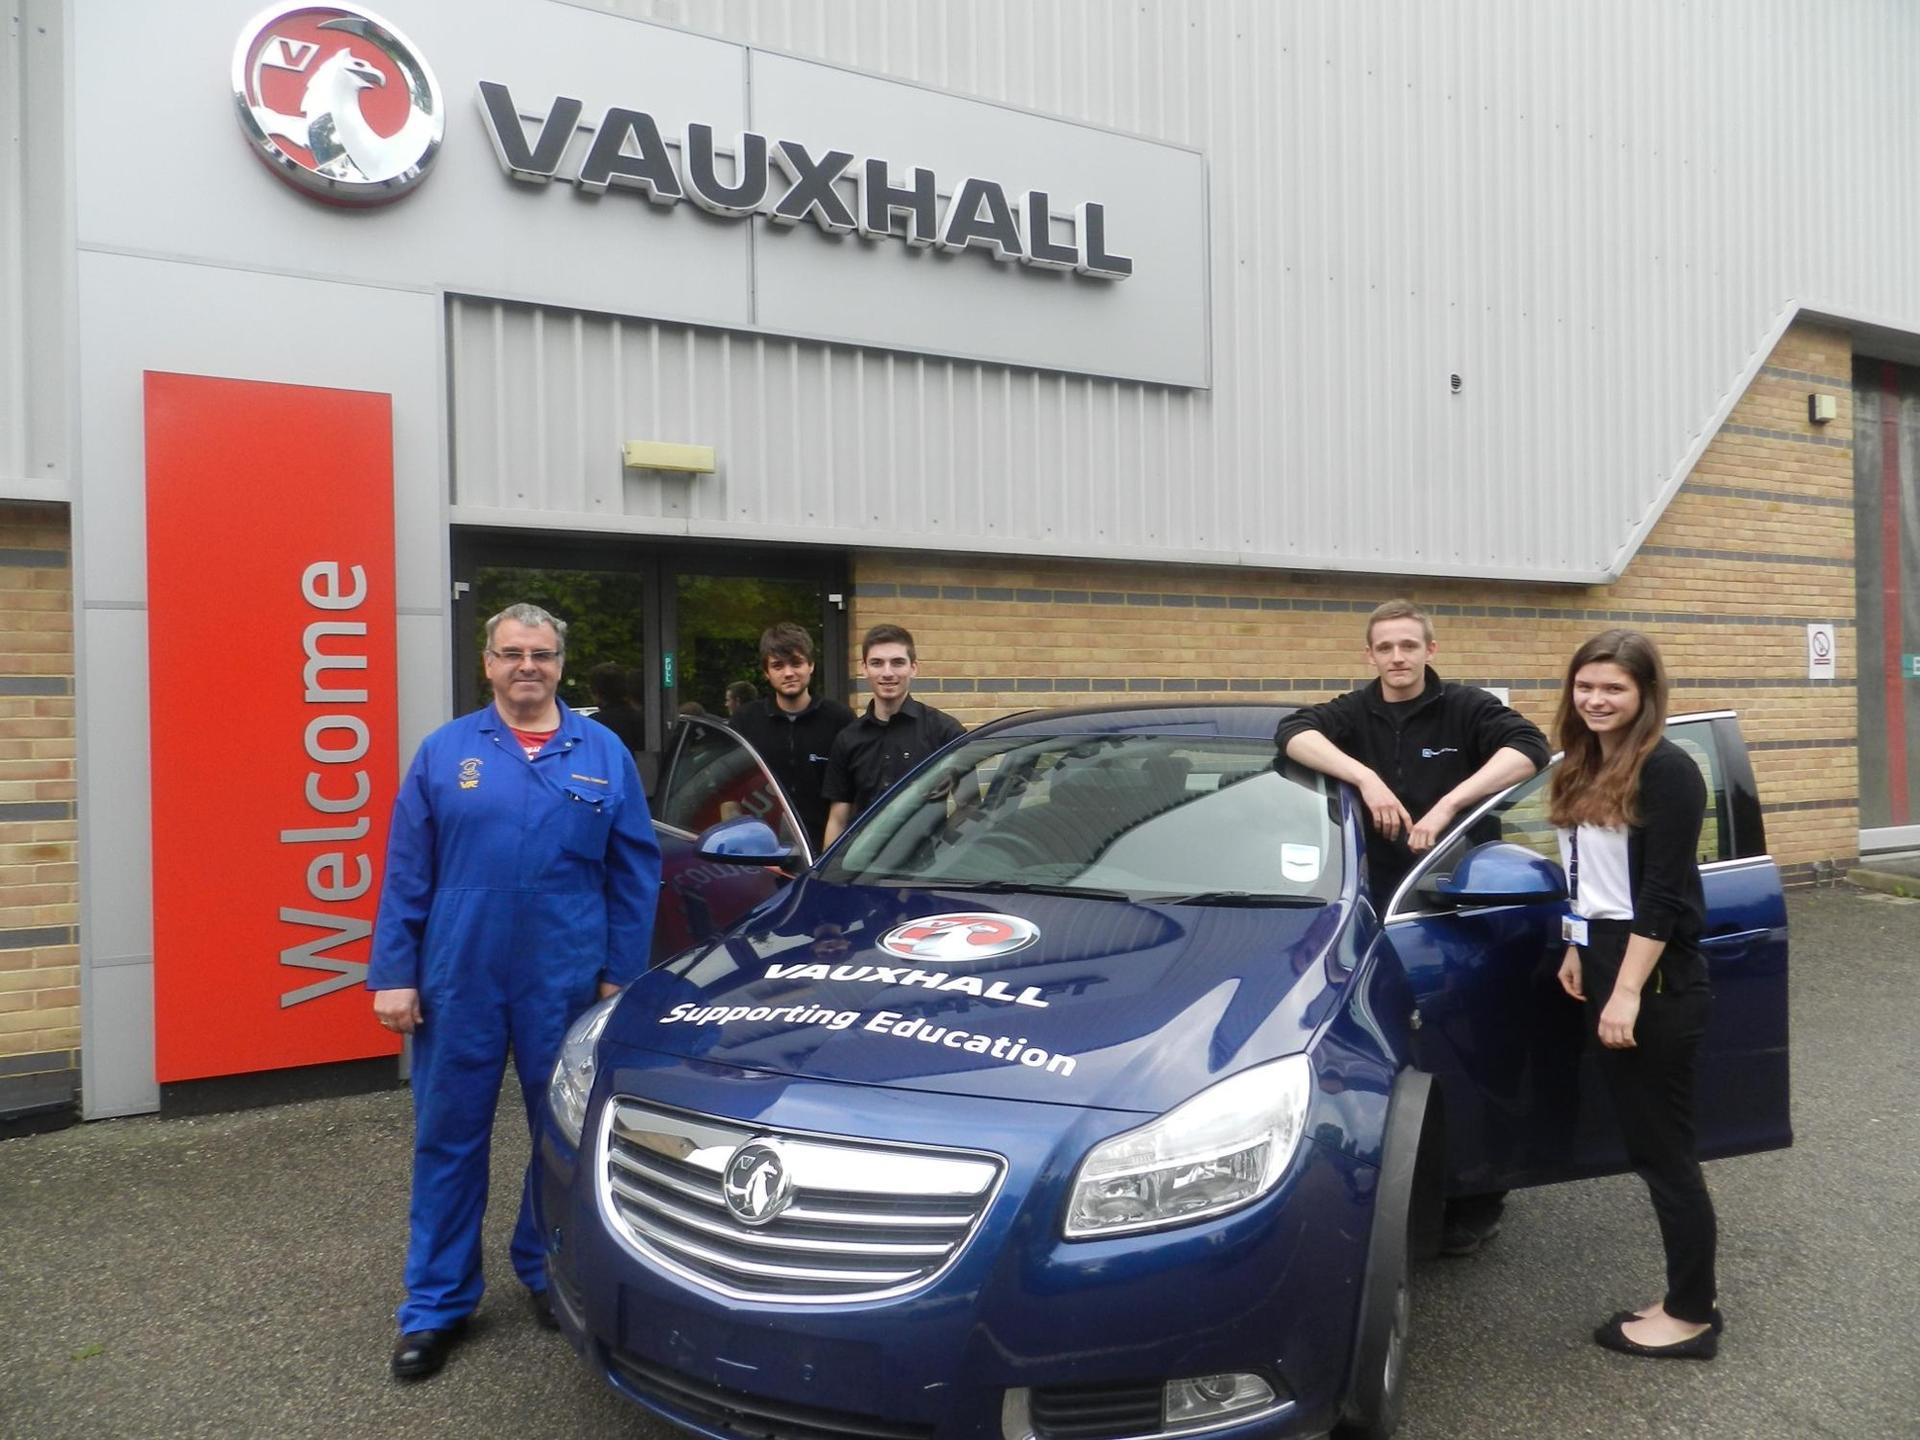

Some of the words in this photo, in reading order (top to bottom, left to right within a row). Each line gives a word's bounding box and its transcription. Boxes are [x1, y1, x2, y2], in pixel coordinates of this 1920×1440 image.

[478, 80, 1132, 278] VAUXHALL
[280, 560, 373, 1008] Welcome
[659, 1002, 861, 1031] Supporting
[864, 1010, 1078, 1078] Education
[763, 963, 1051, 1009] VAUXHALL
